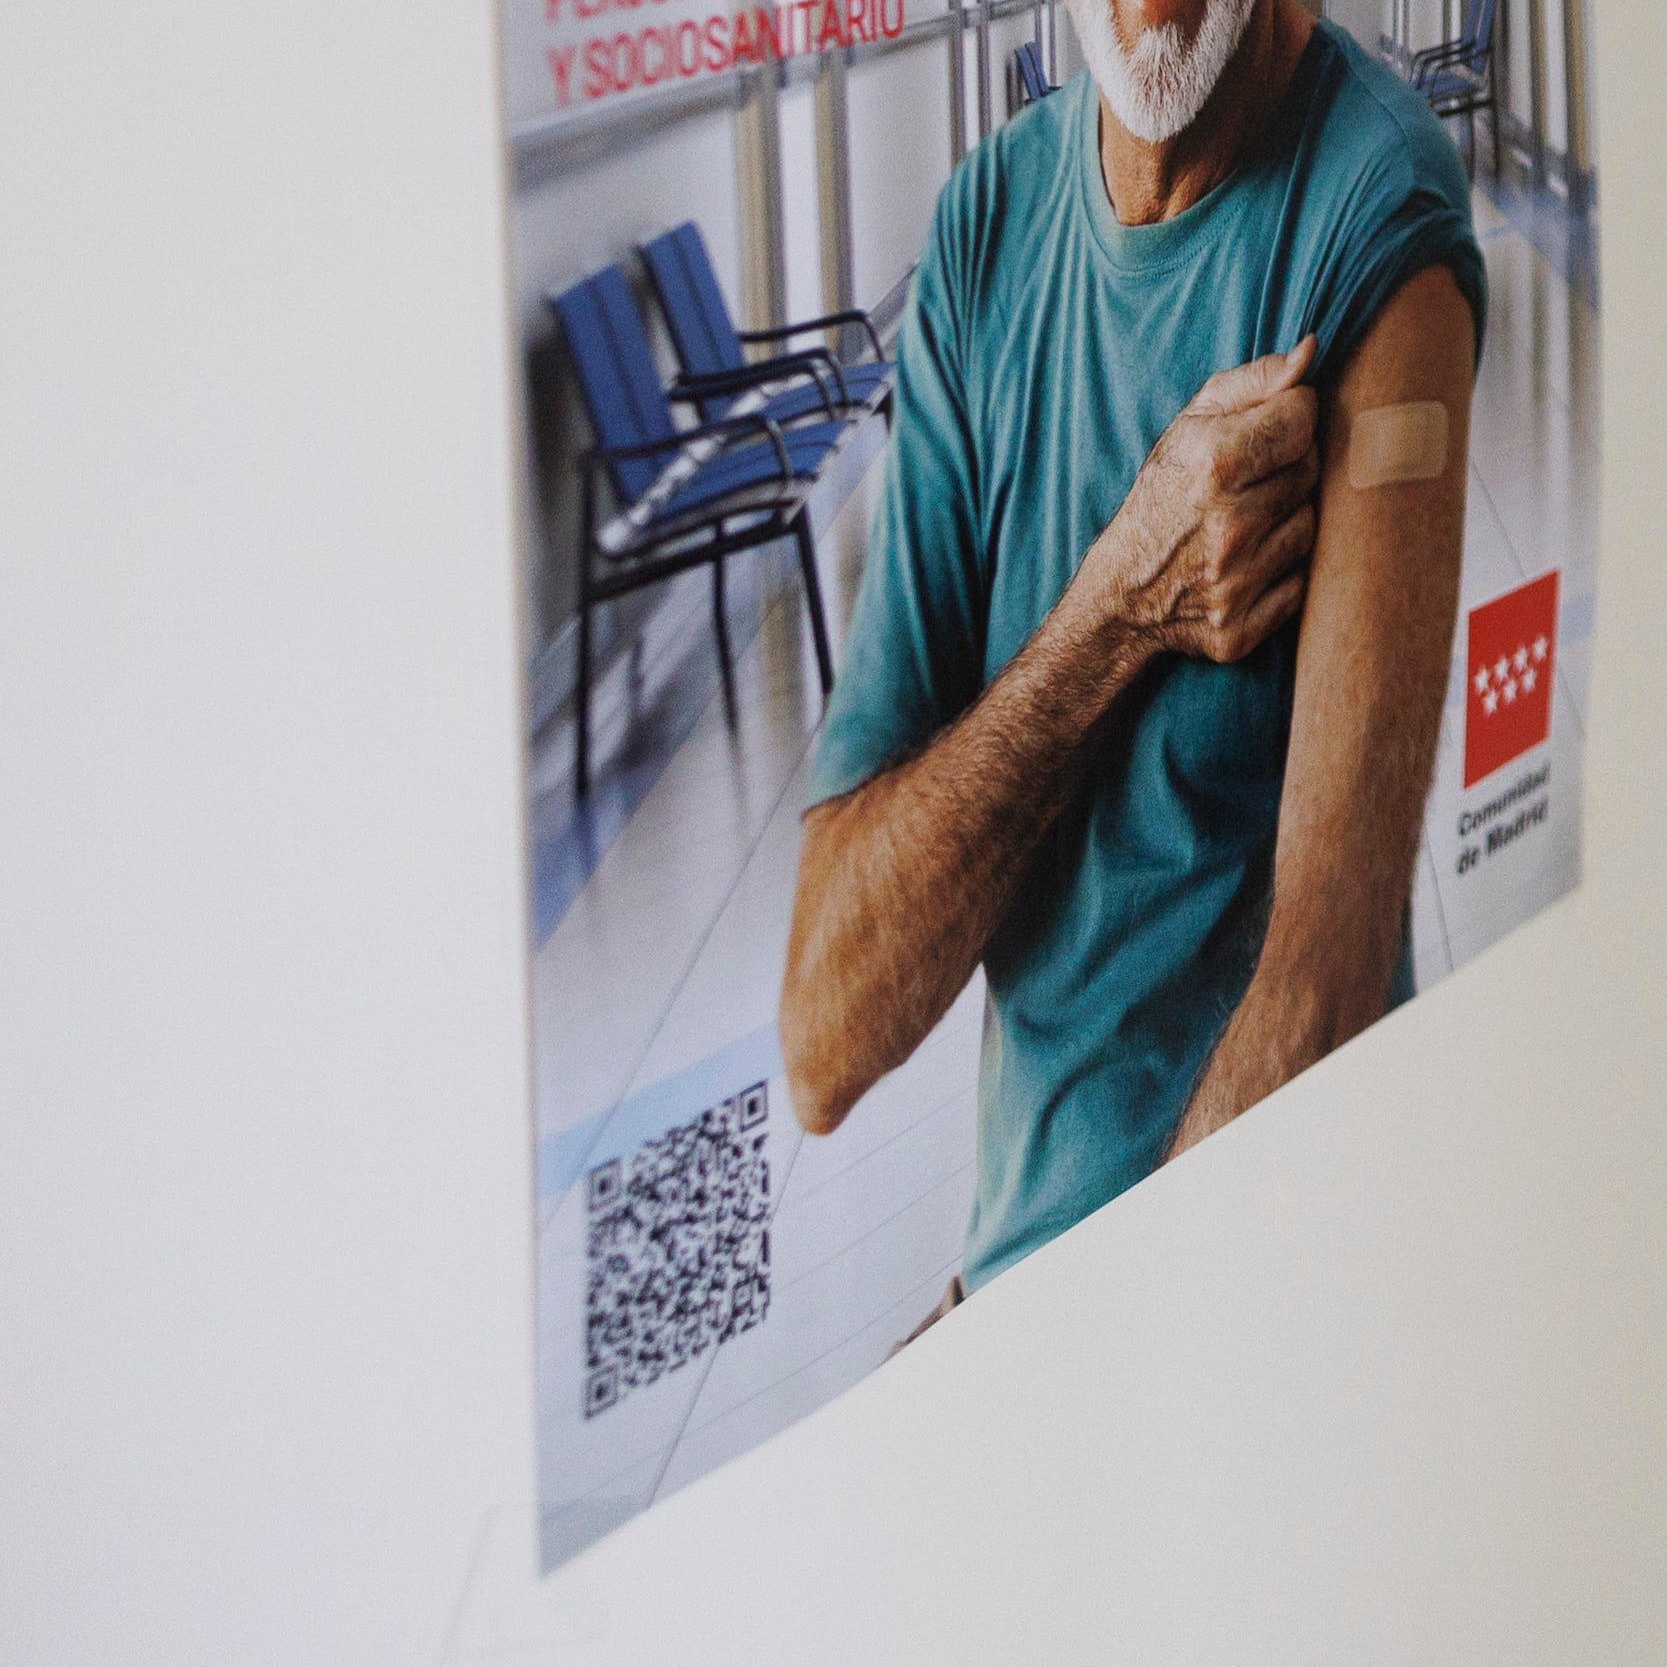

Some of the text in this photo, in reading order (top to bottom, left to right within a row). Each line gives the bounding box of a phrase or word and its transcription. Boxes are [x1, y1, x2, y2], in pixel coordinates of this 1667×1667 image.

[546, 44, 577, 109] Y
[1456, 795, 1548, 876] de Madrid
[1459, 761, 1550, 837] Comunidad
